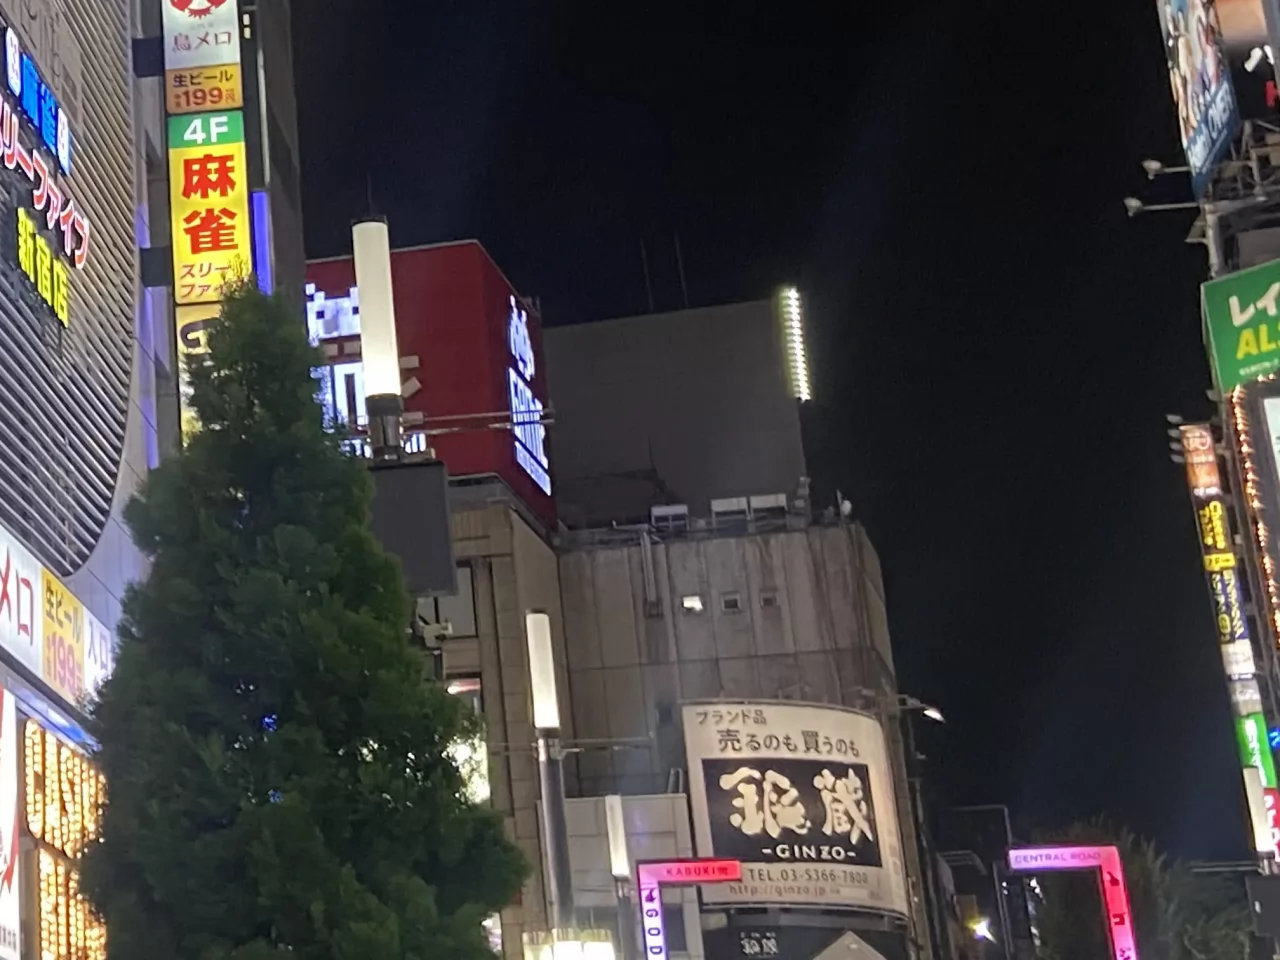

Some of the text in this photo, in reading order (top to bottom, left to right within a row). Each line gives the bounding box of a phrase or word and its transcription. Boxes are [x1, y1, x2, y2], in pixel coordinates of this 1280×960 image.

[173, 31, 231, 53] 鳥メロ
[173, 70, 233, 87] 生ビール
[183, 116, 228, 144] 4F
[182, 154, 239, 254] 麻雀
[17, 206, 69, 328] 新宿店
[1236, 320, 1280, 360] AL
[45, 578, 81, 643] 生ビール
[696, 709, 767, 726] ブランド品
[1014, 851, 1101, 864] CENTRAL ROAD
